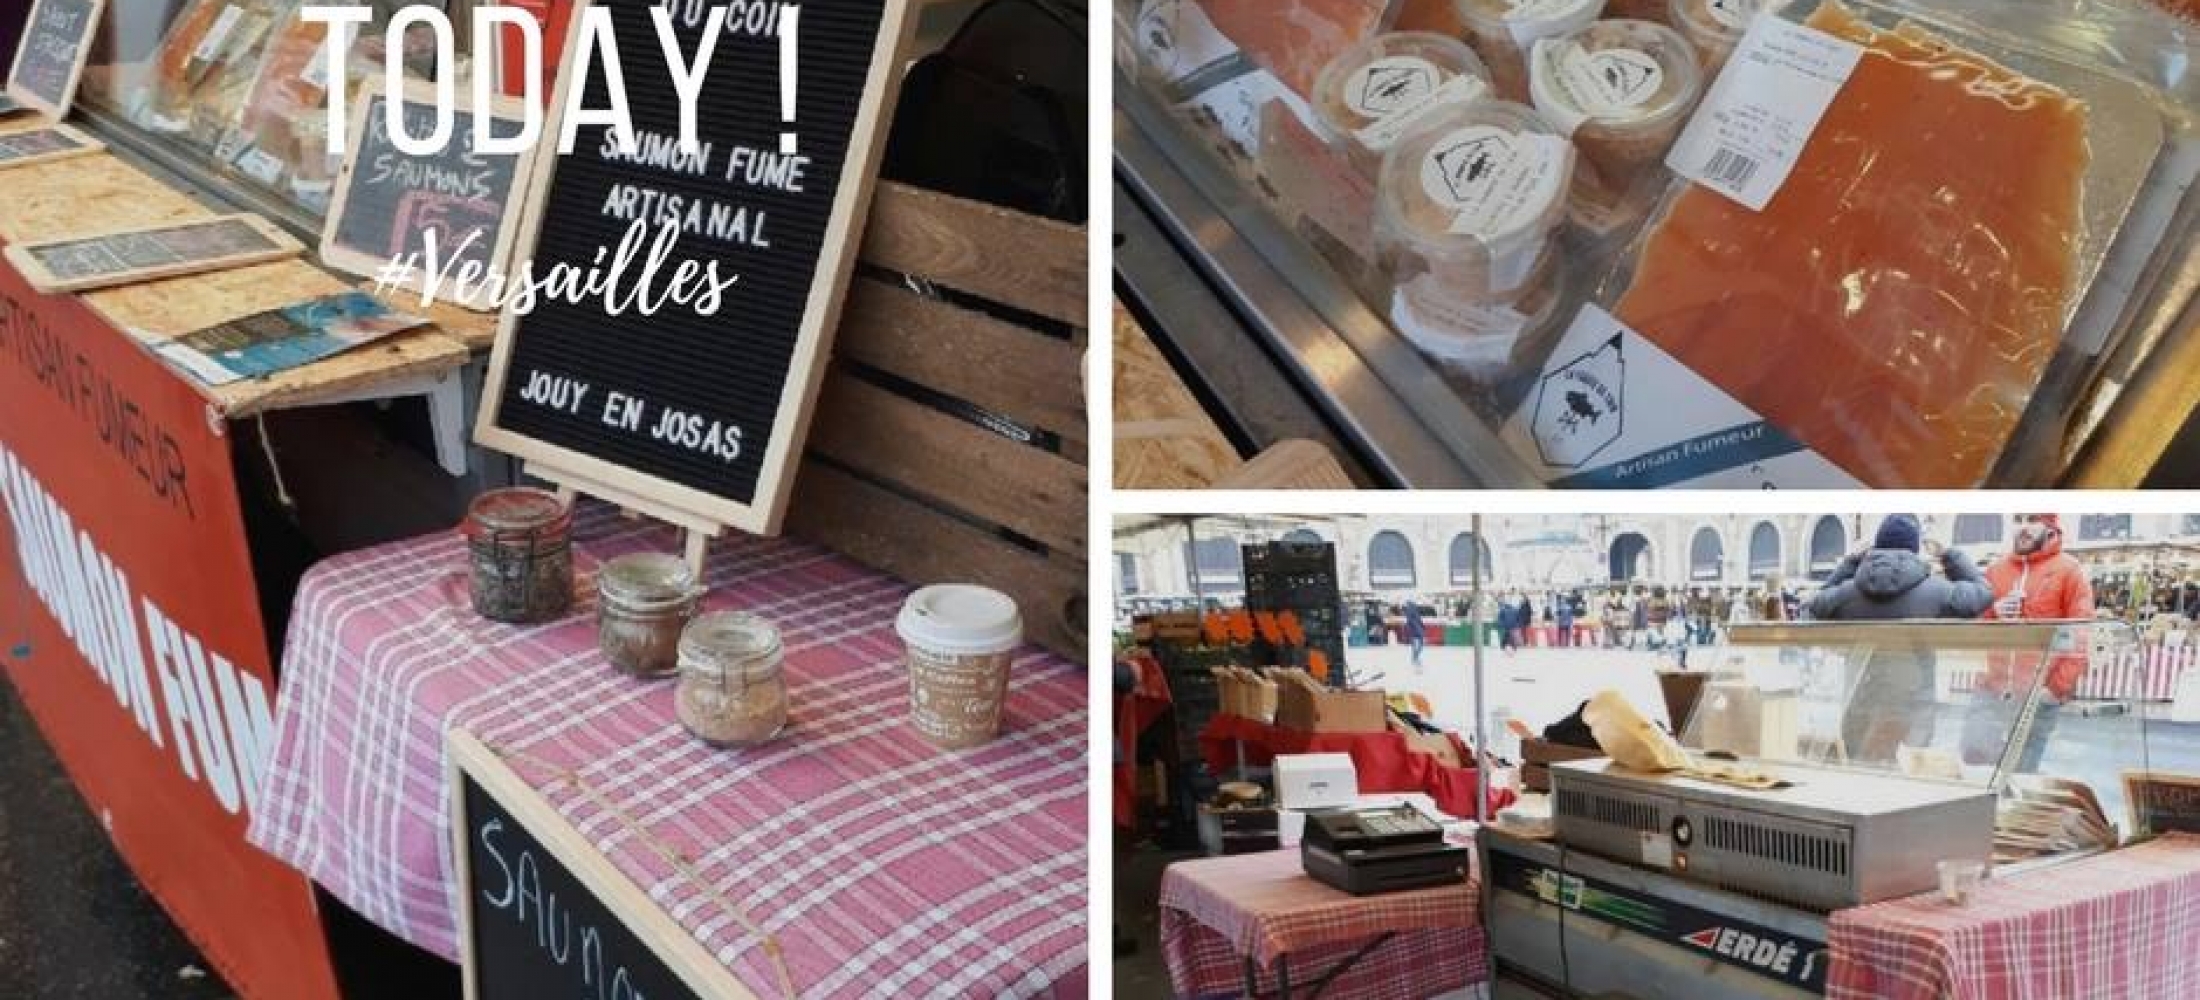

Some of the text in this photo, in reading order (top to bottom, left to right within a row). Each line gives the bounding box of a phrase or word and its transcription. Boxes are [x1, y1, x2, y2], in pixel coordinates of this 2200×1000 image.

[725, 0, 799, 38] COI
[725, 146, 811, 192] FUME
[601, 183, 771, 248] ARTISANAL
[520, 369, 743, 462] JOUY EN JOSAS
[1615, 426, 1762, 479] Artisan Fumeur
[1716, 926, 1798, 975] ERDÉ
